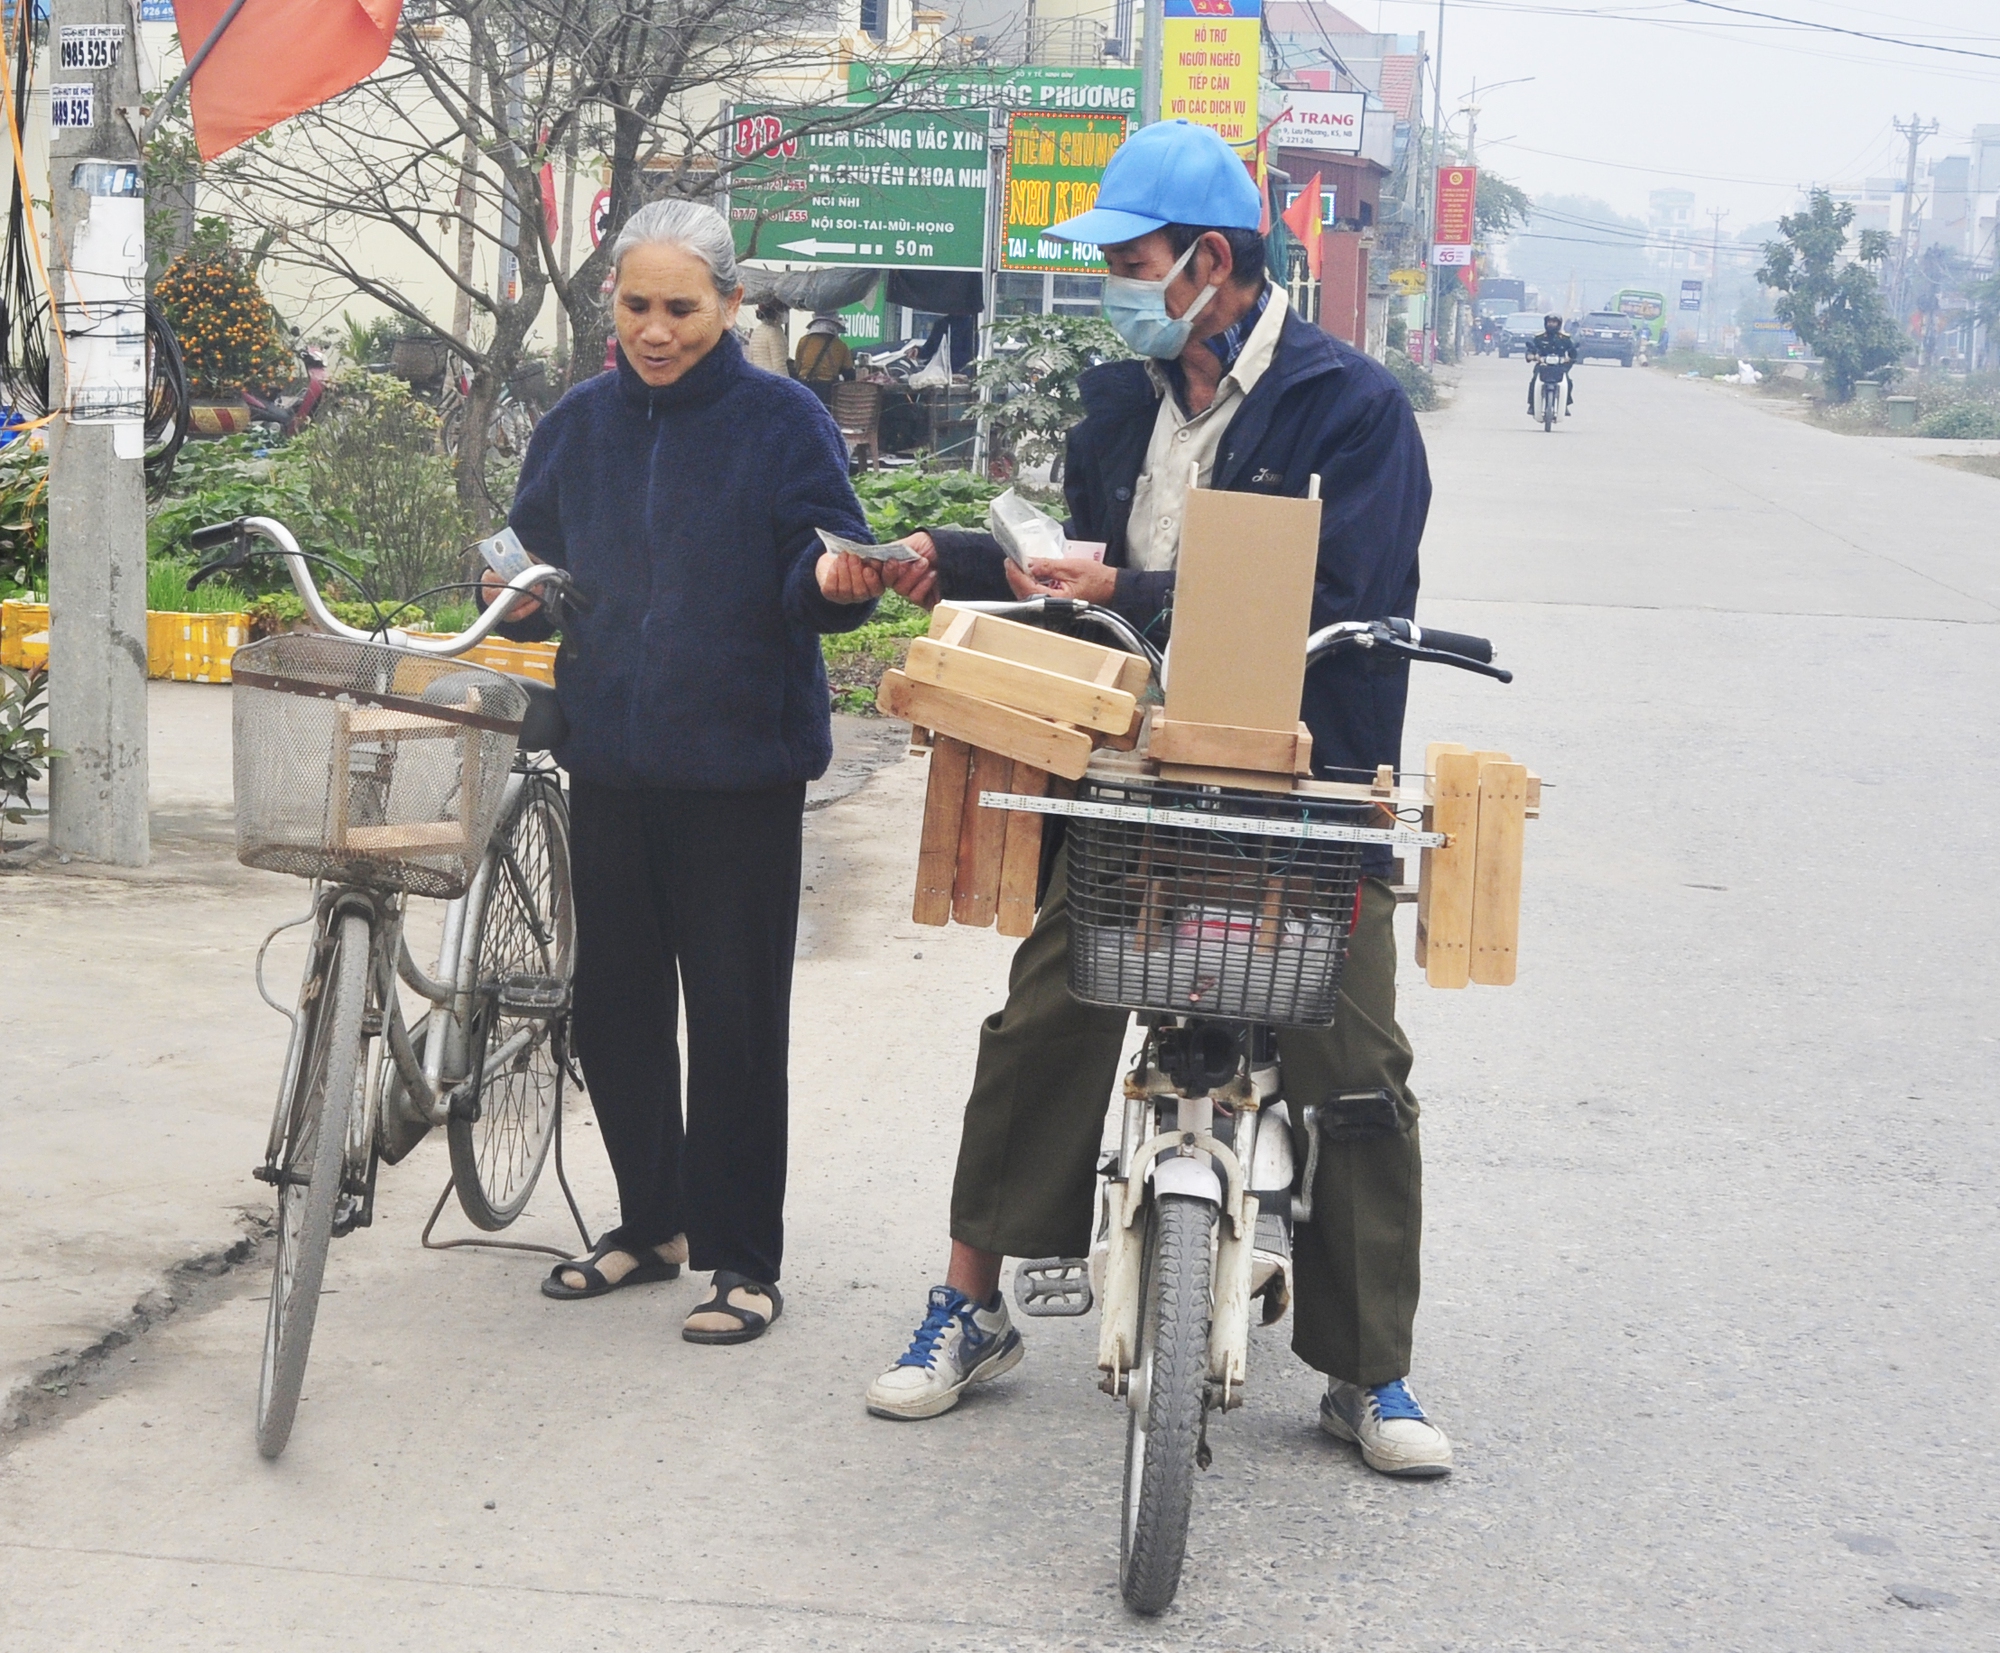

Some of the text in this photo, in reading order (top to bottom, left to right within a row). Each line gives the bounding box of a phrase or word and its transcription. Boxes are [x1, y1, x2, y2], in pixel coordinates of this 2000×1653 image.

[143, 6, 160, 16] 926
[1209, 28, 1228, 46] TRỢ
[1179, 48, 1241, 67] NGƯỜI NGHÈO
[1188, 71, 1230, 93] TIẾP CẬN
[1039, 83, 1136, 108] PHƯƠNG
[1171, 95, 1246, 118] VỚI CÁC DỊCH VỤ
[1299, 112, 1354, 126] TRANG
[853, 122, 911, 149] CHỦNG
[916, 122, 948, 150] VẮC
[952, 130, 983, 151] XIN
[811, 215, 834, 231] NỘI
[895, 240, 934, 257] 50m
[1008, 238, 1027, 258] TAI
